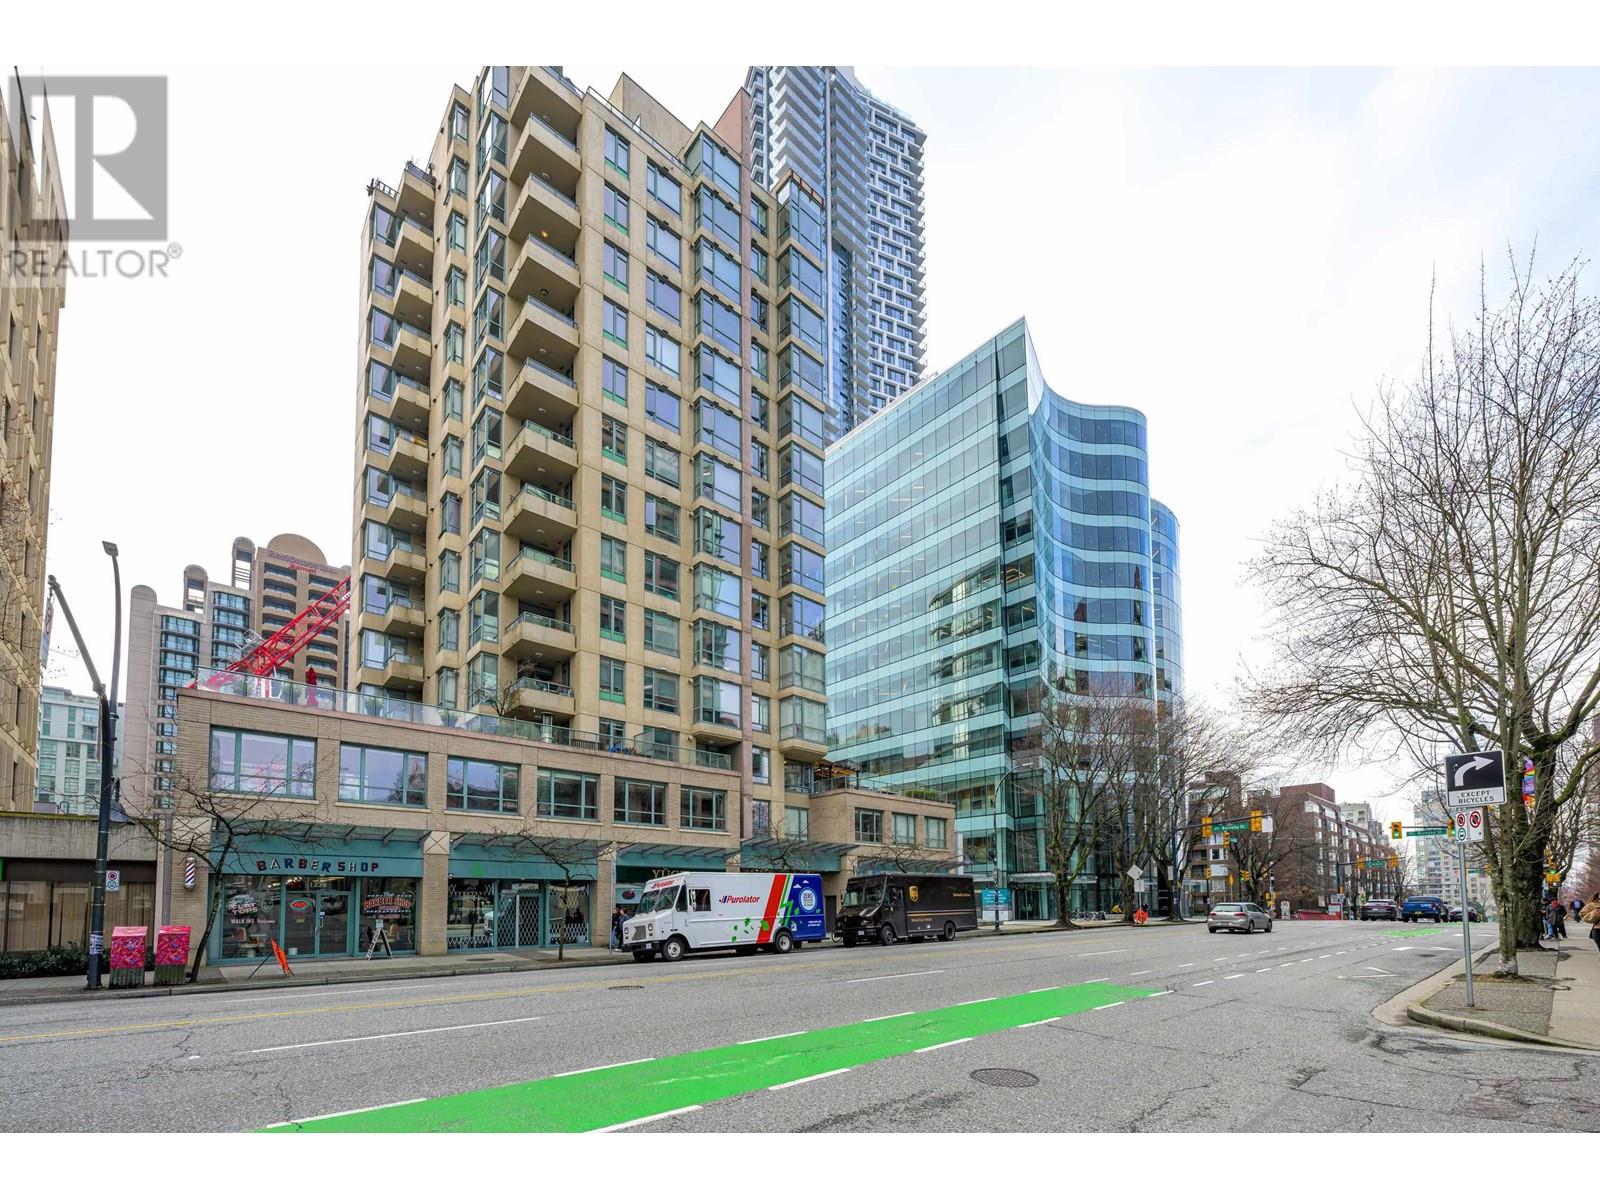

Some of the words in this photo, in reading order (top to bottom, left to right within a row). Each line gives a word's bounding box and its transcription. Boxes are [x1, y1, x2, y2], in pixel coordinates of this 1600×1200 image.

[1461, 790, 1490, 798] EXCEPT
[1458, 796, 1495, 804] BICYCLES
[256, 857, 331, 873] BARBER
[337, 861, 379, 873] SHOP
[363, 897, 394, 910] BARBER
[726, 895, 760, 904] Purolator
